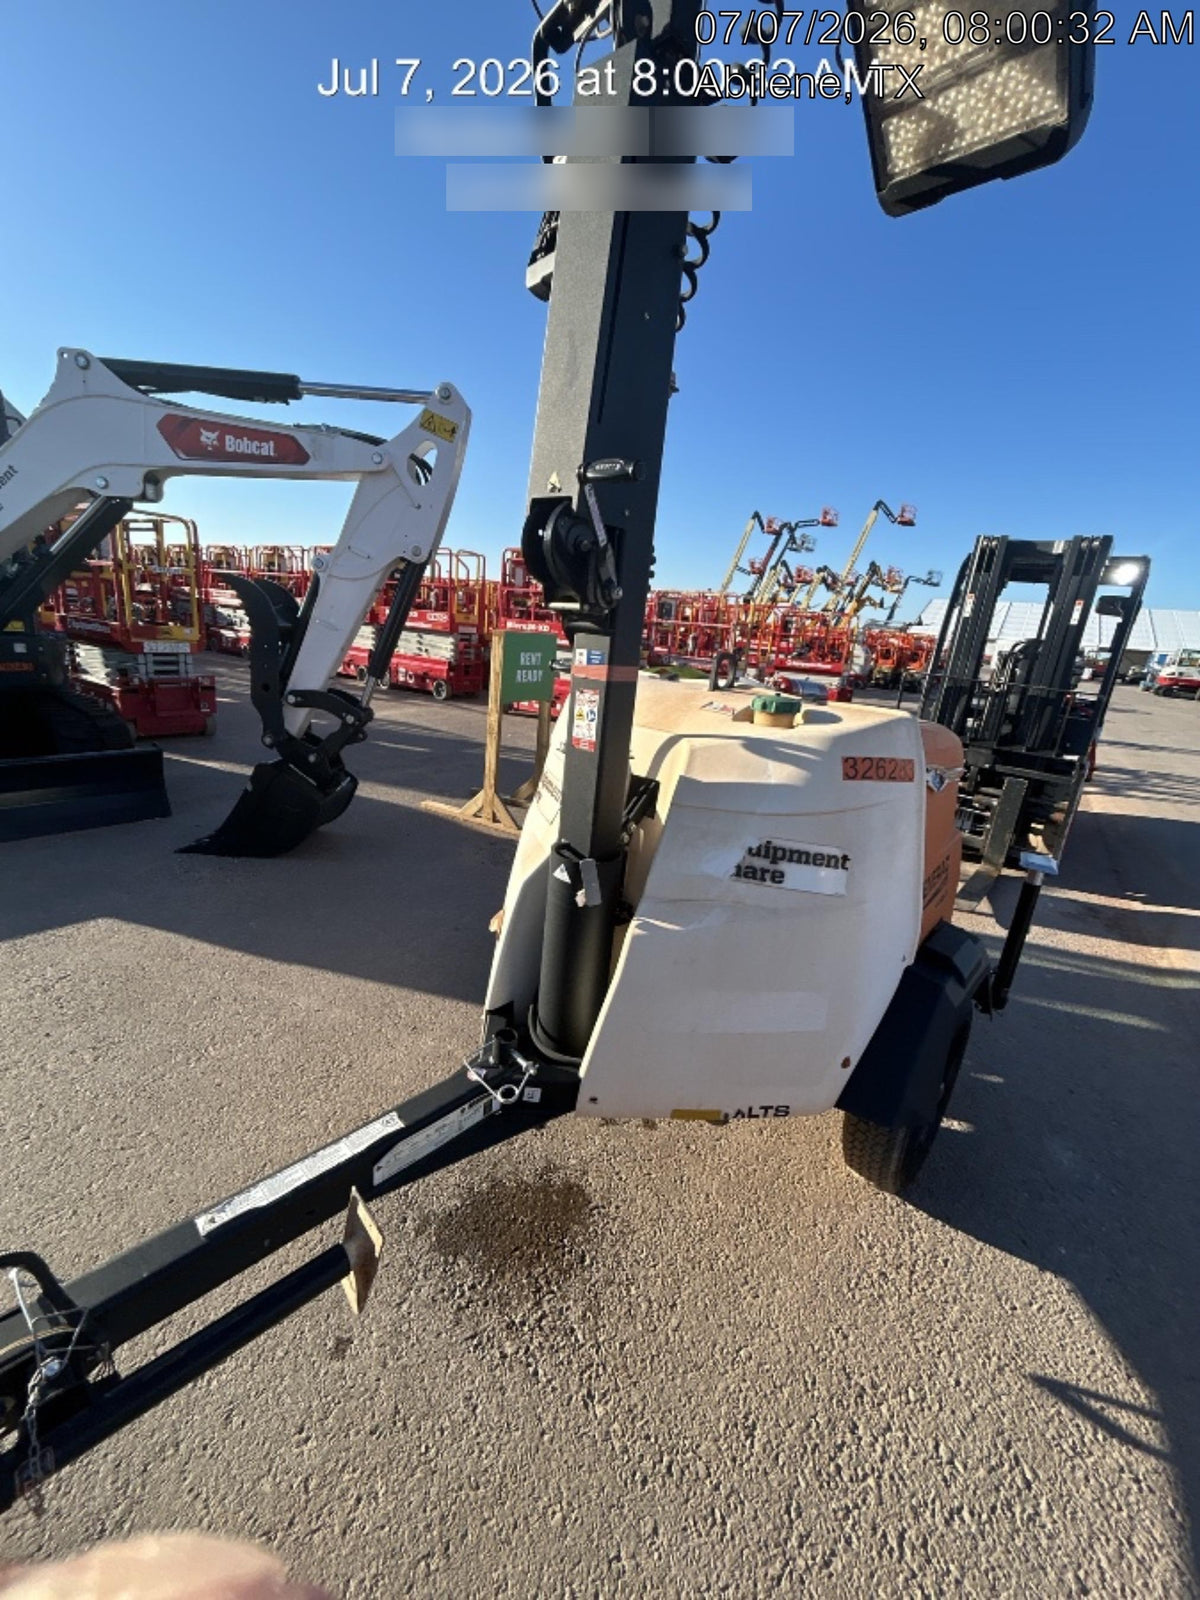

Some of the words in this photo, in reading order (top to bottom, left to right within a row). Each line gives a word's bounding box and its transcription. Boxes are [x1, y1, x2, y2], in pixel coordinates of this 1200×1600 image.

[225, 434, 275, 457] Bobcat
[520, 652, 541, 666] RENT
[516, 669, 543, 683] READY
